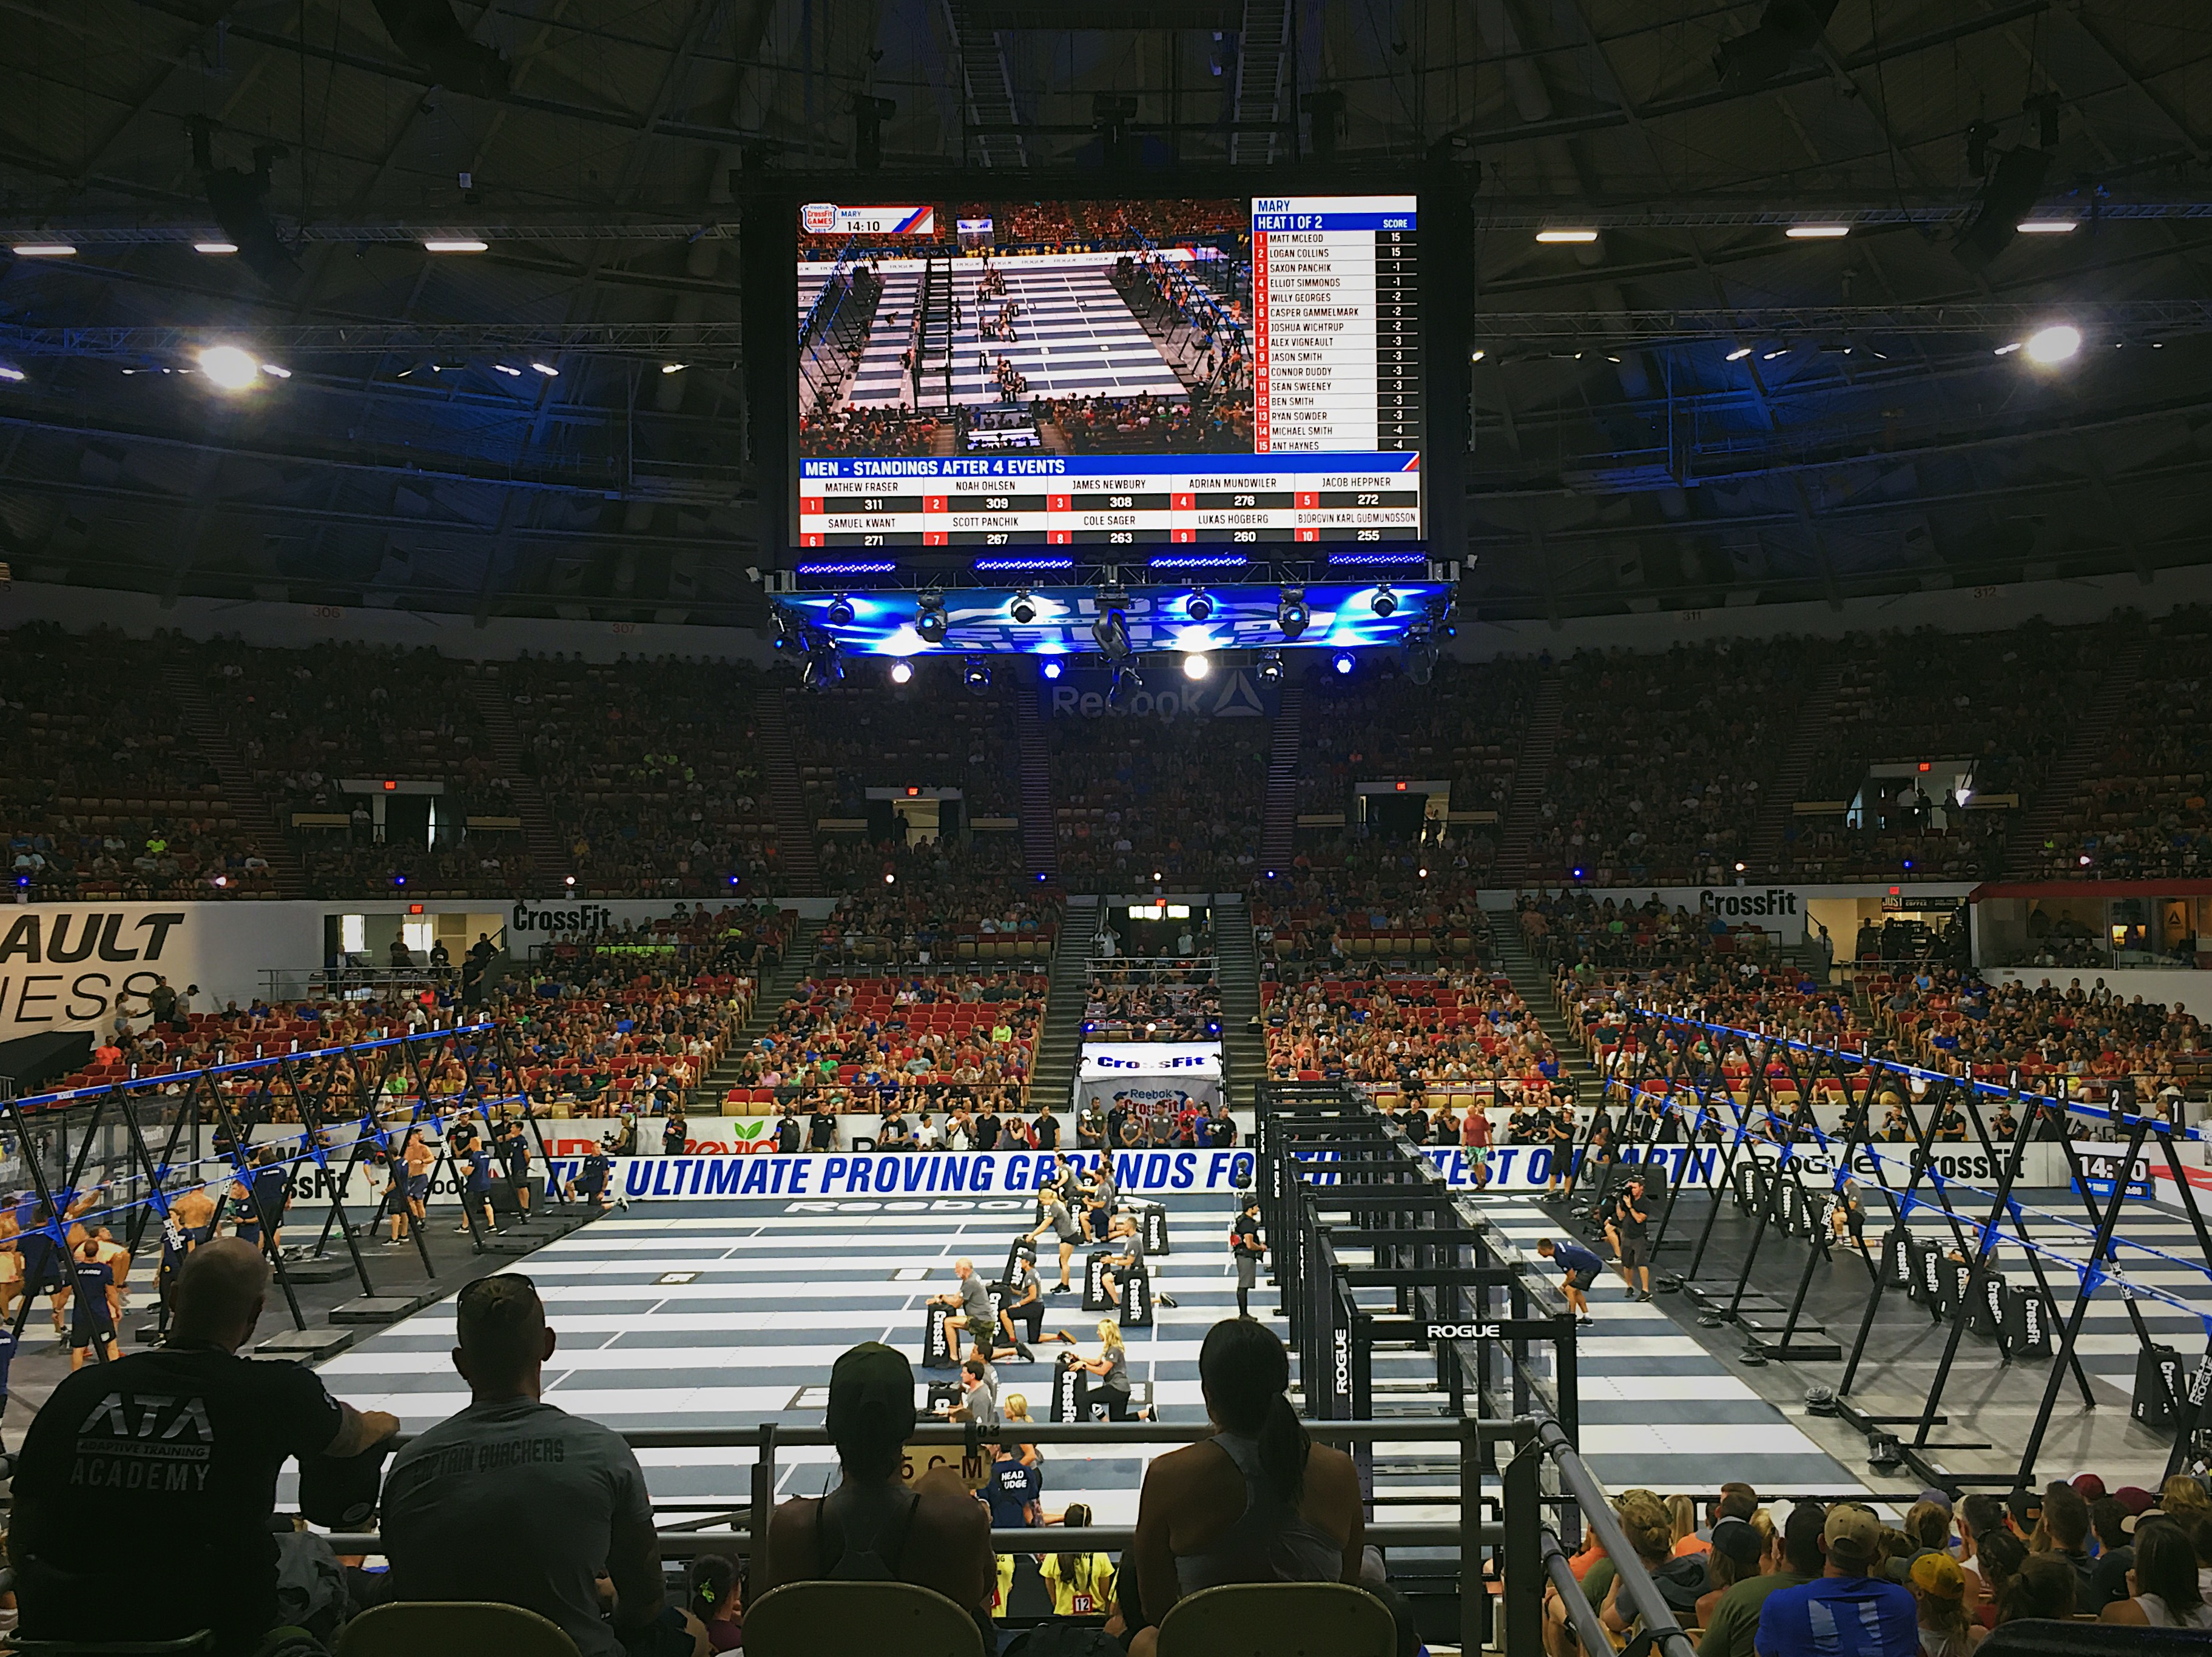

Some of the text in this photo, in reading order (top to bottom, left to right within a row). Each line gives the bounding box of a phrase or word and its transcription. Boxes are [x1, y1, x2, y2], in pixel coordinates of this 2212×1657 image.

[1258, 200, 1290, 212] MARY
[847, 221, 880, 232] 14:10
[1258, 215, 1323, 229] HEAT 1 OF 2
[1383, 219, 1408, 229] SCORE
[1259, 232, 1401, 243] 1 MATT MCLEOD 15
[1258, 247, 1401, 258] 2 LOGAN COLLINS 15
[1258, 262, 1400, 273] 3 SAXON PANCHIK -1
[1258, 277, 1400, 288] 4 ELLIOT SIMMONDS -1
[1258, 291, 1401, 303] 5 WILLY GEORGES -2
[1258, 306, 1401, 318] 6 CASPER GAMMELMARK -2
[1259, 321, 1401, 332] 7 JOSHUA WICHTRUP -2
[1259, 336, 1401, 348] 8 ALEX VIGNEAULT -3
[1259, 351, 1402, 362] 9 JASON SMITH -3
[1257, 365, 1402, 377] 10 CONNOR DUDDY -3
[1259, 380, 1402, 392] 11 SEAN SWEENEY -3
[1258, 395, 1403, 406] 12 BEN SMITH -3
[1258, 410, 1403, 422] 13 RYAN SOWDER -3
[1258, 425, 1403, 436] 14 MICHAEL SMITH -4
[1258, 440, 1403, 451] 15 ANT HAYNES -4
[805, 459, 1066, 476] MEN STANDINGS AFTER 4 EVENTS
[825, 482, 898, 492] MATHEW FRASER
[956, 480, 1015, 491] NOAH OHLSEN
[1073, 479, 1146, 489] JAMES NEWBURY
[1189, 478, 1276, 488] ADRIAN MUNDWILER
[1322, 477, 1391, 487] JACOB HEPPNER
[865, 499, 882, 510] 311
[933, 499, 939, 509] 2
[986, 498, 1008, 509] 309
[1057, 497, 1064, 508] 3
[1110, 496, 1133, 508] 308
[1180, 496, 1187, 506] 4
[1234, 495, 1255, 506] 276
[1304, 495, 1310, 506] 5
[1357, 494, 1379, 505] 272
[811, 500, 815, 511] 1
[828, 518, 895, 528] SAMUEL KWANT
[953, 517, 1019, 527] SCOTT PANCHIK
[1084, 516, 1135, 526] COLE SAGER
[1198, 514, 1226, 525] LUKAS
[1337, 514, 1355, 523] KARL
[809, 536, 816, 546] 6
[864, 535, 883, 546] 271
[933, 535, 940, 545] 7
[986, 534, 1008, 545] 267
[1057, 533, 1064, 544] 8
[1110, 533, 1133, 543] 263
[1181, 532, 1187, 543] 9
[1233, 531, 1256, 542] 260
[1303, 531, 1313, 542] 10
[1357, 530, 1380, 541] 255
[1701, 889, 1798, 916] CrossFit
[513, 904, 612, 932] CrossFit
[0, 913, 185, 964] AULT
[0, 972, 162, 1024] ESS
[217, 1049, 224, 1065] 8
[130, 1063, 138, 1080] 6
[2010, 1069, 2017, 1089] 4
[1130, 1089, 1173, 1100] Reebok
[2058, 1078, 2065, 1100] 3
[2111, 1089, 2120, 1112] 2
[2173, 1101, 2179, 1124] 1
[625, 1158, 812, 1197] ULTIMATE
[820, 1154, 995, 1194] PROVING
[1745, 1169, 1755, 1200] CrossFit
[1897, 1242, 1910, 1280] CrossFit
[1925, 1252, 1940, 1293] CrossFit
[1129, 1278, 1142, 1321] CrossFit
[2025, 1299, 2041, 1345] CrossFit
[932, 1310, 947, 1357] CrossFit
[1428, 1324, 1500, 1339] ROGUE
[1335, 1328, 1348, 1395] ROGUE
[1062, 1370, 1076, 1423] CrossFit
[79, 1440, 206, 1457] ADAPTIVE TRAINING
[70, 1458, 211, 1491] ACADEMY
[1001, 1470, 1024, 1481] HEAD
[1003, 1478, 1028, 1490] UDGE
[1076, 1597, 1090, 1612] 12
